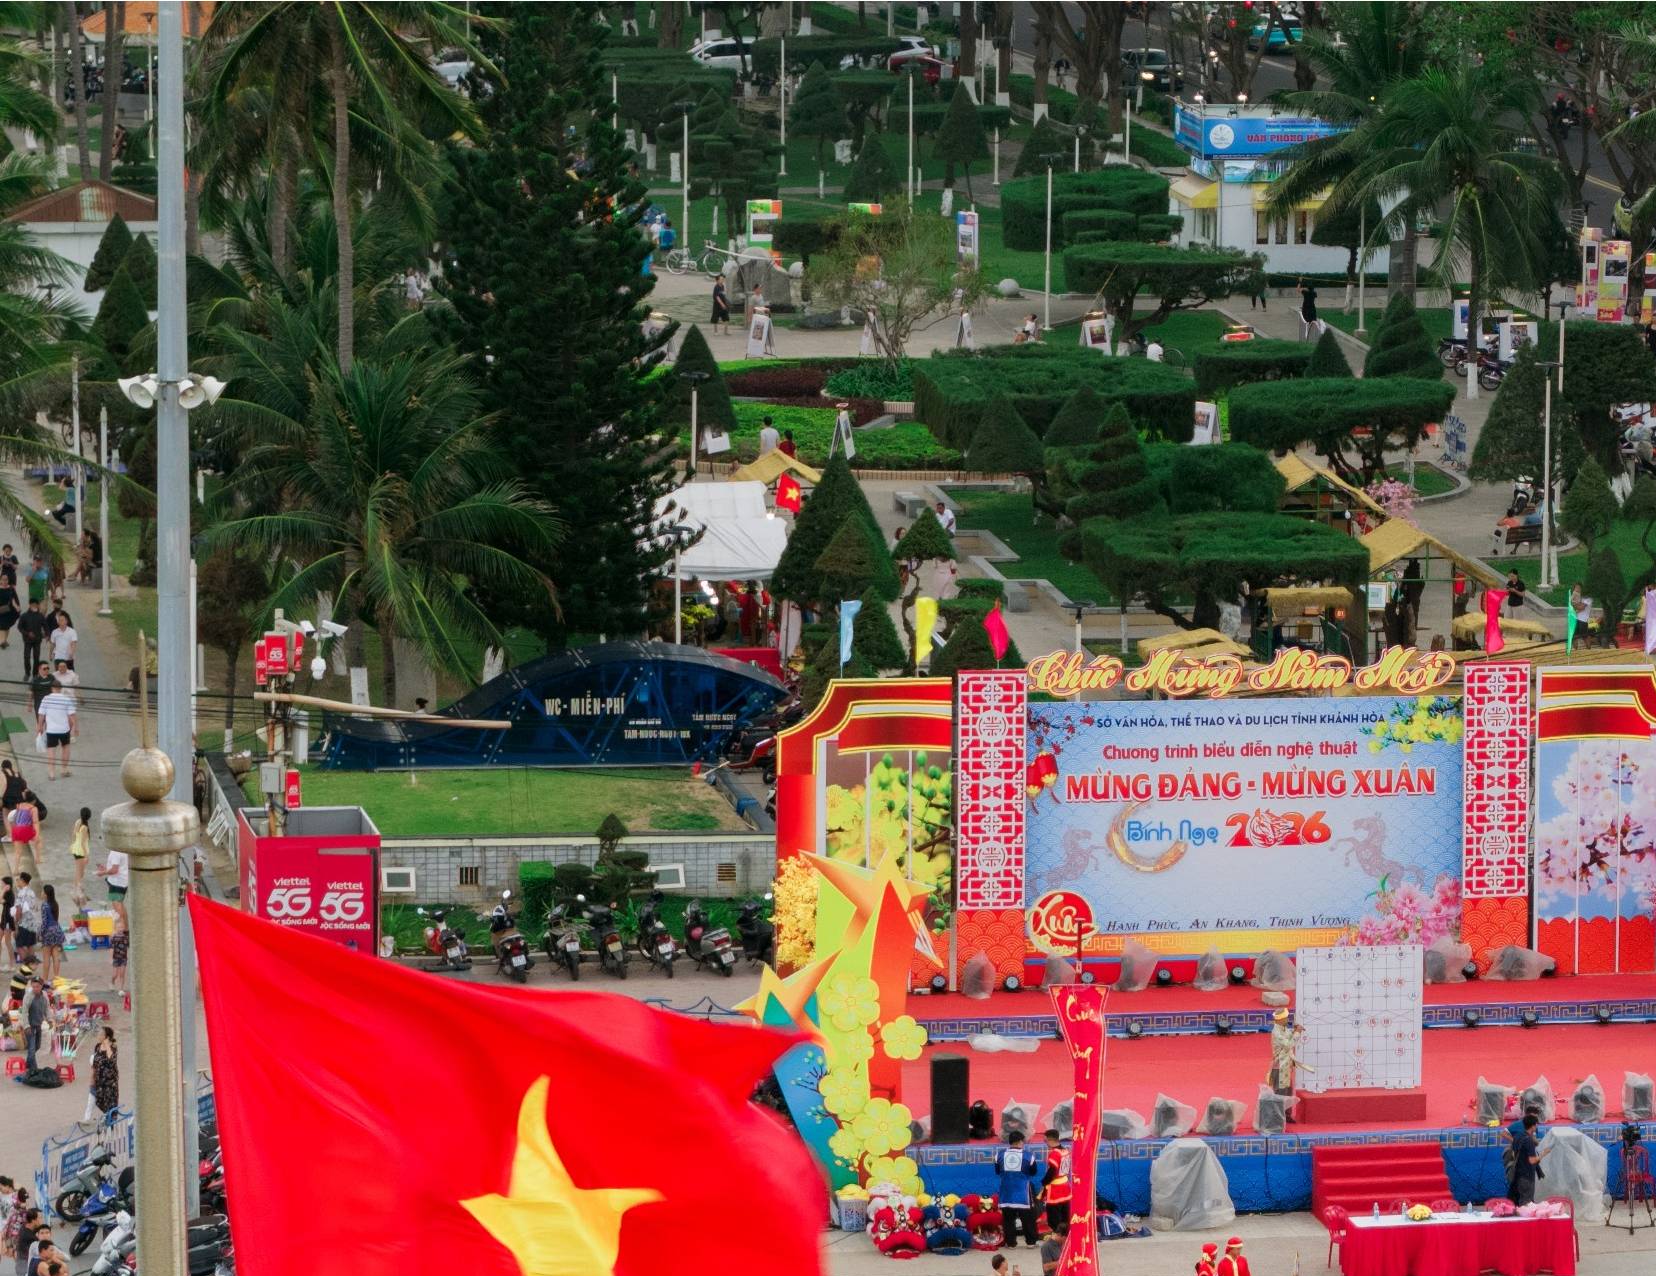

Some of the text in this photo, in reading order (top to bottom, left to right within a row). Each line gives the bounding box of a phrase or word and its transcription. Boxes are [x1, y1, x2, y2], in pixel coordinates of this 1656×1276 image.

[1027, 645, 1456, 698] Chúc Mừng Năm Mới
[1097, 715, 1112, 728] SỞ
[1114, 715, 1138, 728] VĂN
[1170, 711, 1192, 727] THỂ
[1194, 715, 1225, 727] THAO
[1228, 713, 1242, 726] VÀ
[1245, 715, 1261, 726] DU
[1263, 714, 1288, 728] LỊCH
[1291, 711, 1317, 725] TỈNH
[1320, 711, 1359, 724] KHÁNH
[1361, 711, 1385, 724] HÒA
[1102, 739, 1358, 763] Chương trình biểu diễn nghệ thuật
[1066, 767, 1152, 803] MỪNG
[1158, 765, 1242, 801] ĐẢNG
[1261, 764, 1347, 799] MỪNG
[1353, 761, 1436, 796] XUÂN
[1127, 819, 1172, 842] Bính
[1179, 818, 1219, 846] Ngọ
[273, 877, 312, 886] viettel
[327, 882, 364, 890] viettel
[266, 887, 312, 918] 5G
[319, 892, 365, 921] 5G
